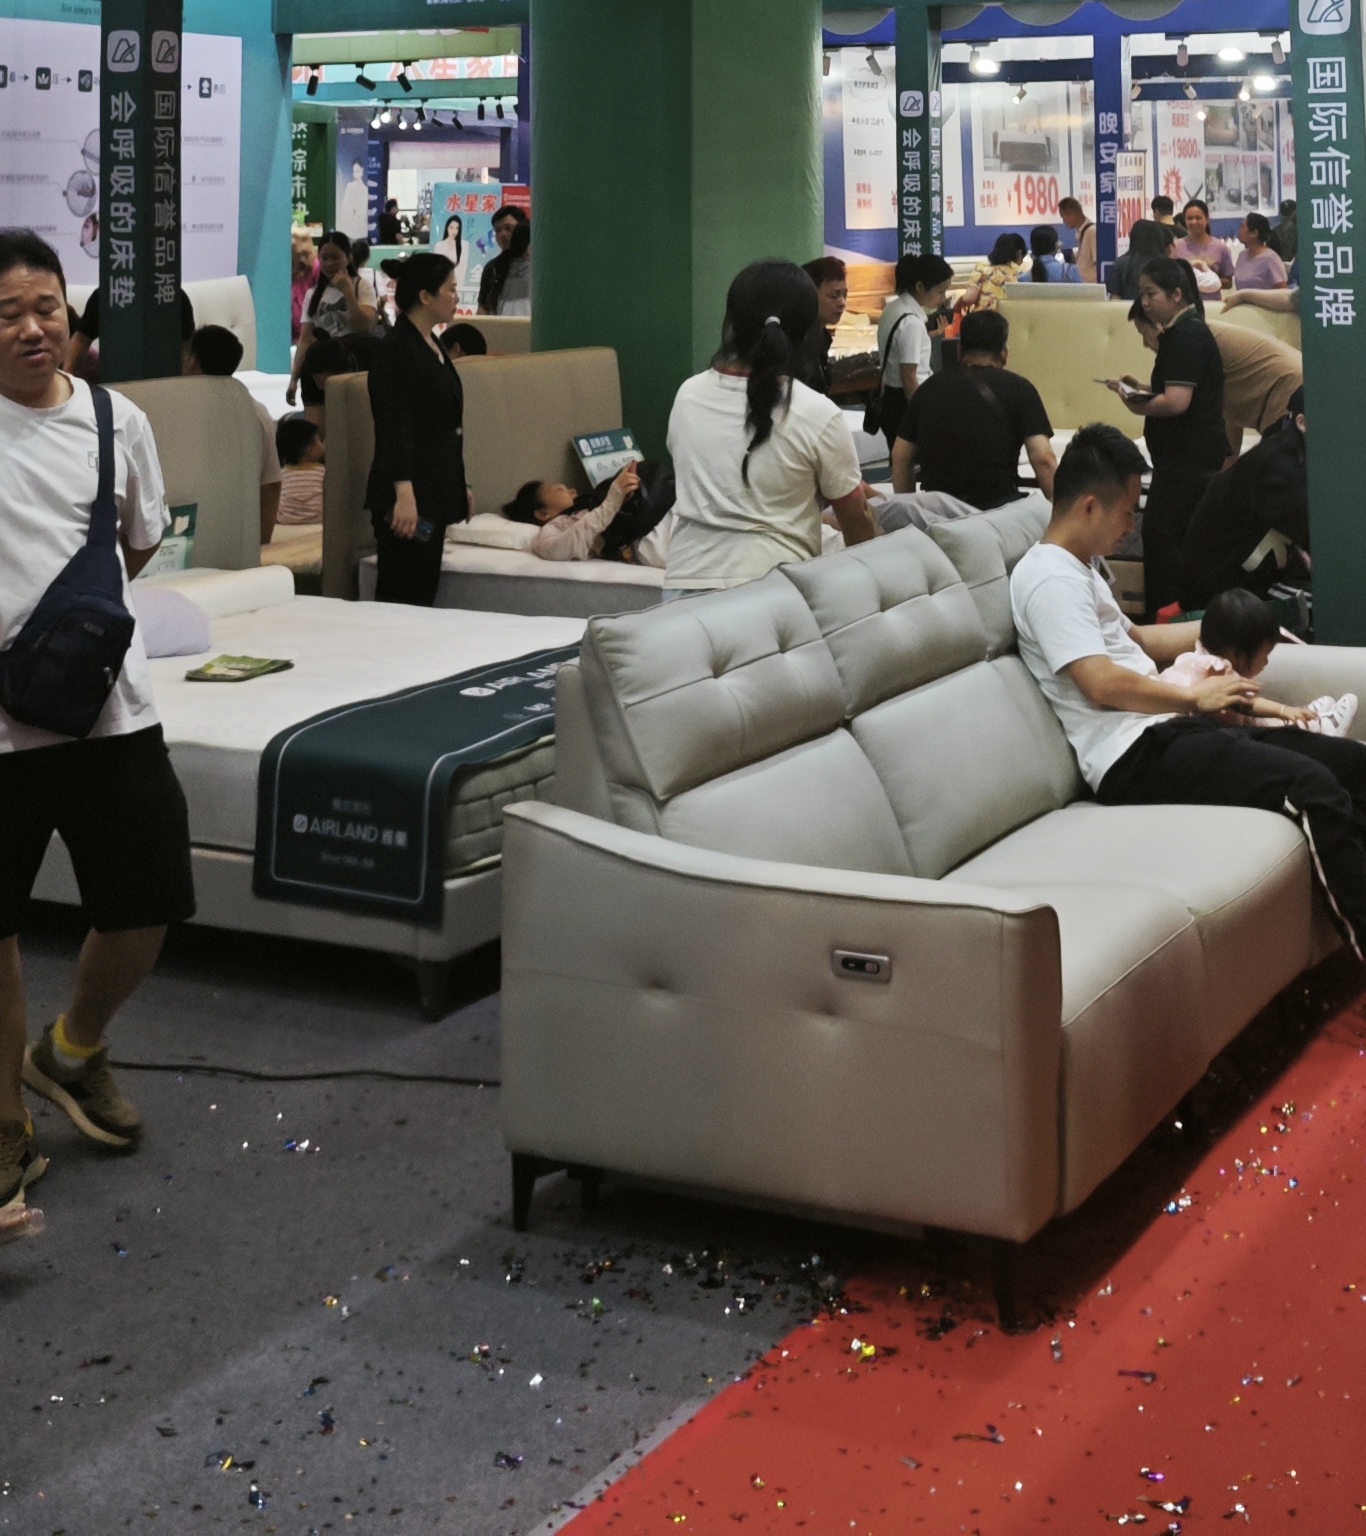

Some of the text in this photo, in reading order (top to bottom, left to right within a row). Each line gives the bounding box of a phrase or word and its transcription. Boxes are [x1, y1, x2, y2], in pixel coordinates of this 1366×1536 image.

[109, 90, 137, 308] 会呼吸的床垫
[152, 89, 177, 306] 国际信誉品牌
[446, 193, 501, 213] 水星家
[1307, 56, 1356, 328] 国际信誉品牌
[310, 817, 378, 843] AIRLAND
